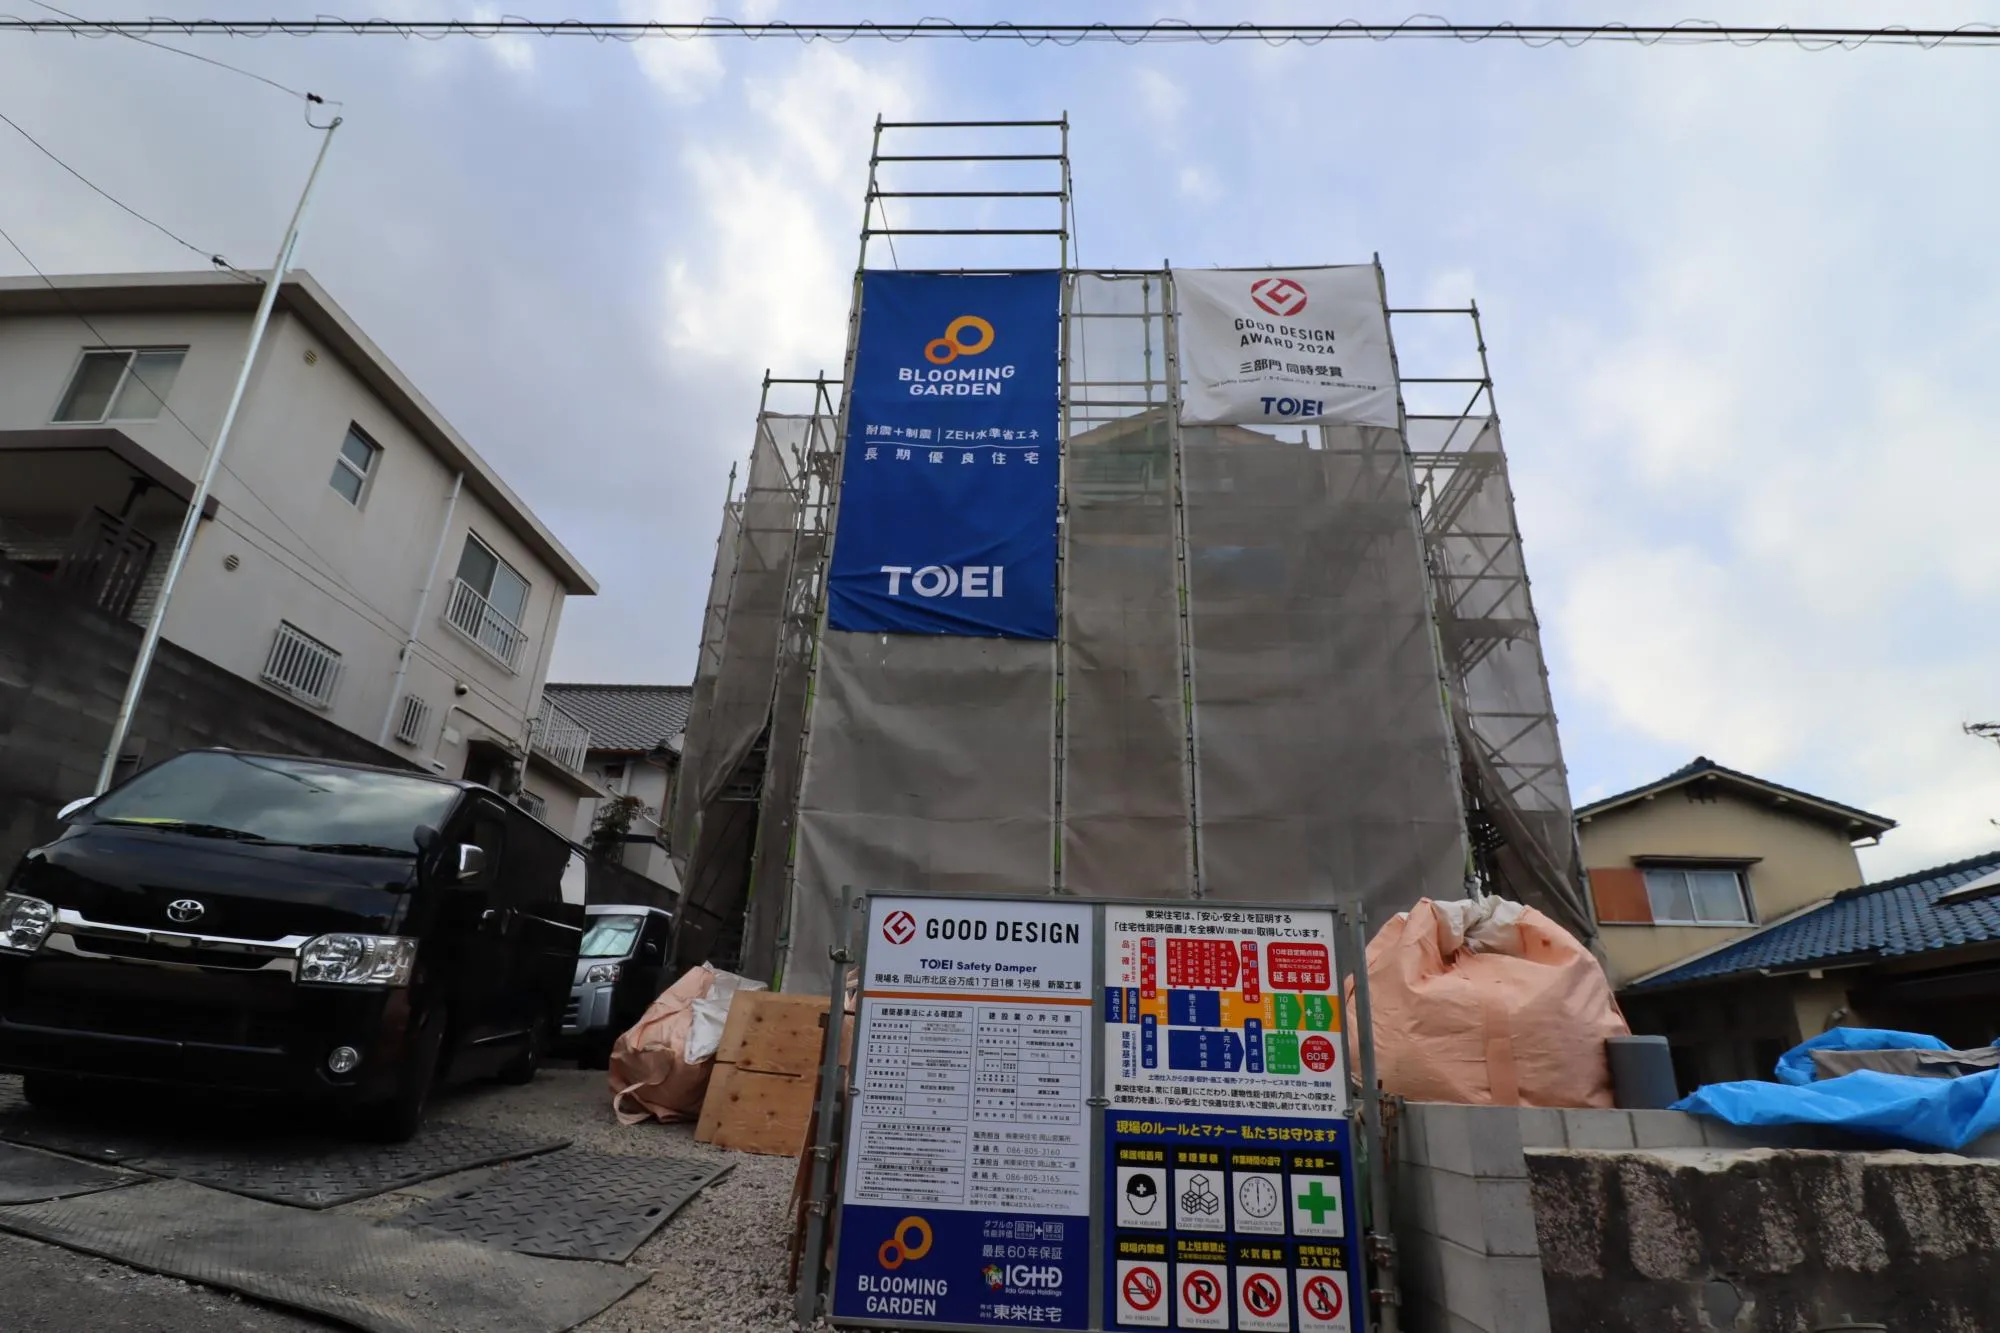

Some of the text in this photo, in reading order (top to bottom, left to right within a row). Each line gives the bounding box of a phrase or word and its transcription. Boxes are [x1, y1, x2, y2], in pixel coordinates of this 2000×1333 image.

[1235, 318, 1335, 341] GOOD DESIGN
[1240, 333, 1335, 354] AWARD 2024
[899, 366, 1015, 382] BLOOMING
[1240, 359, 1343, 378] 三部門 同時受賞
[909, 382, 1001, 396] GARDEN
[945, 428, 1039, 440] ZEH水準省エネ
[864, 447, 1039, 465] 長期優良住宅
[881, 565, 1003, 597] TOEI
[926, 918, 1080, 944] GOOD DESIGN
[920, 959, 1037, 974] TOEI Safety Damper
[875, 974, 900, 983] 現場名
[1018, 979, 1040, 988] 1号棟
[1048, 980, 1081, 990] 新築工事
[1273, 971, 1326, 984] 延長保証
[1306, 1053, 1328, 1061] 60年
[1117, 1120, 1336, 1142] 現場のルールとマナー 私たちは守ります
[982, 1245, 1062, 1260] 最長60年保証
[1005, 1265, 1062, 1287] IGHD
[858, 1275, 948, 1296] BLOOMING
[867, 1297, 936, 1316] GARDEN
[994, 1304, 1062, 1322] 東栄住宅
